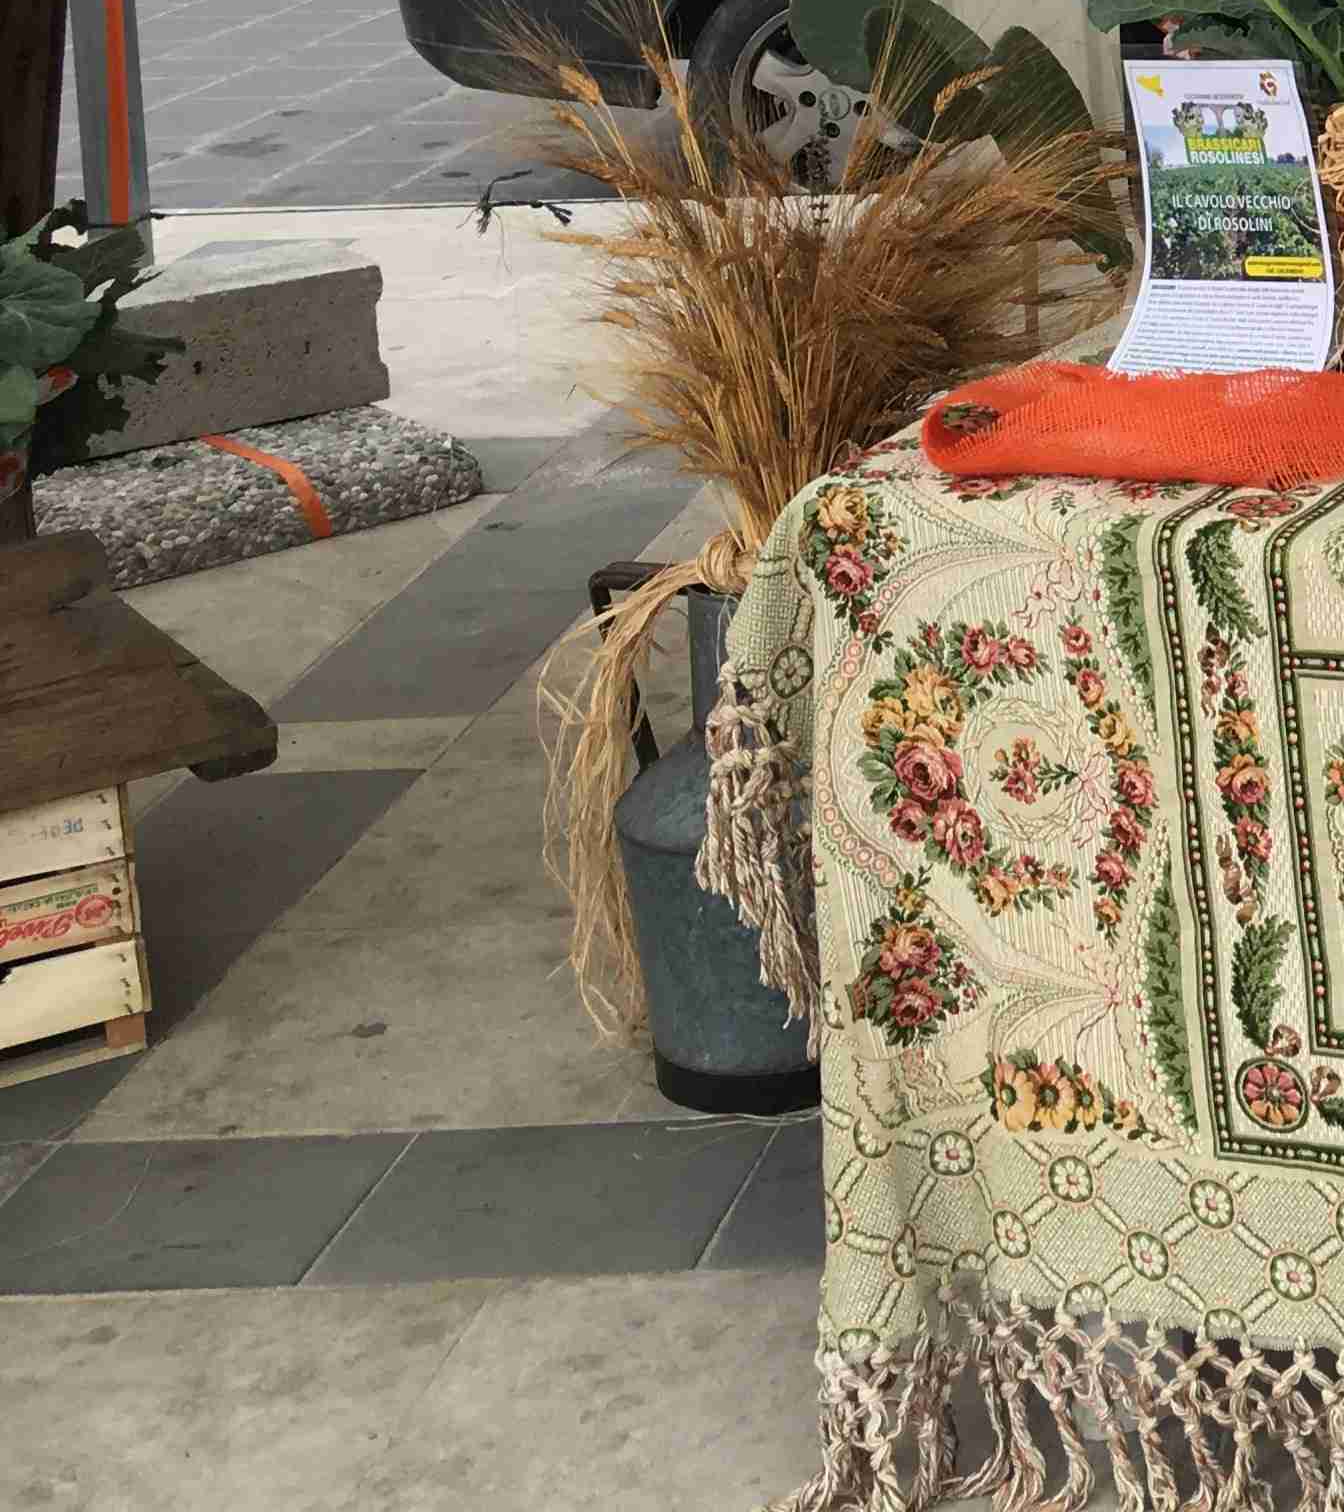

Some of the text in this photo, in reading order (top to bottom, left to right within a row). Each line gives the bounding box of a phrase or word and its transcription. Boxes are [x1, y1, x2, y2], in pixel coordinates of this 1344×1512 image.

[1190, 150, 1265, 165] ROSOLINESI
[1172, 193, 1292, 210] IL CAVOLO VECCHIO
[1197, 216, 1273, 232] DI ROSOLINI
